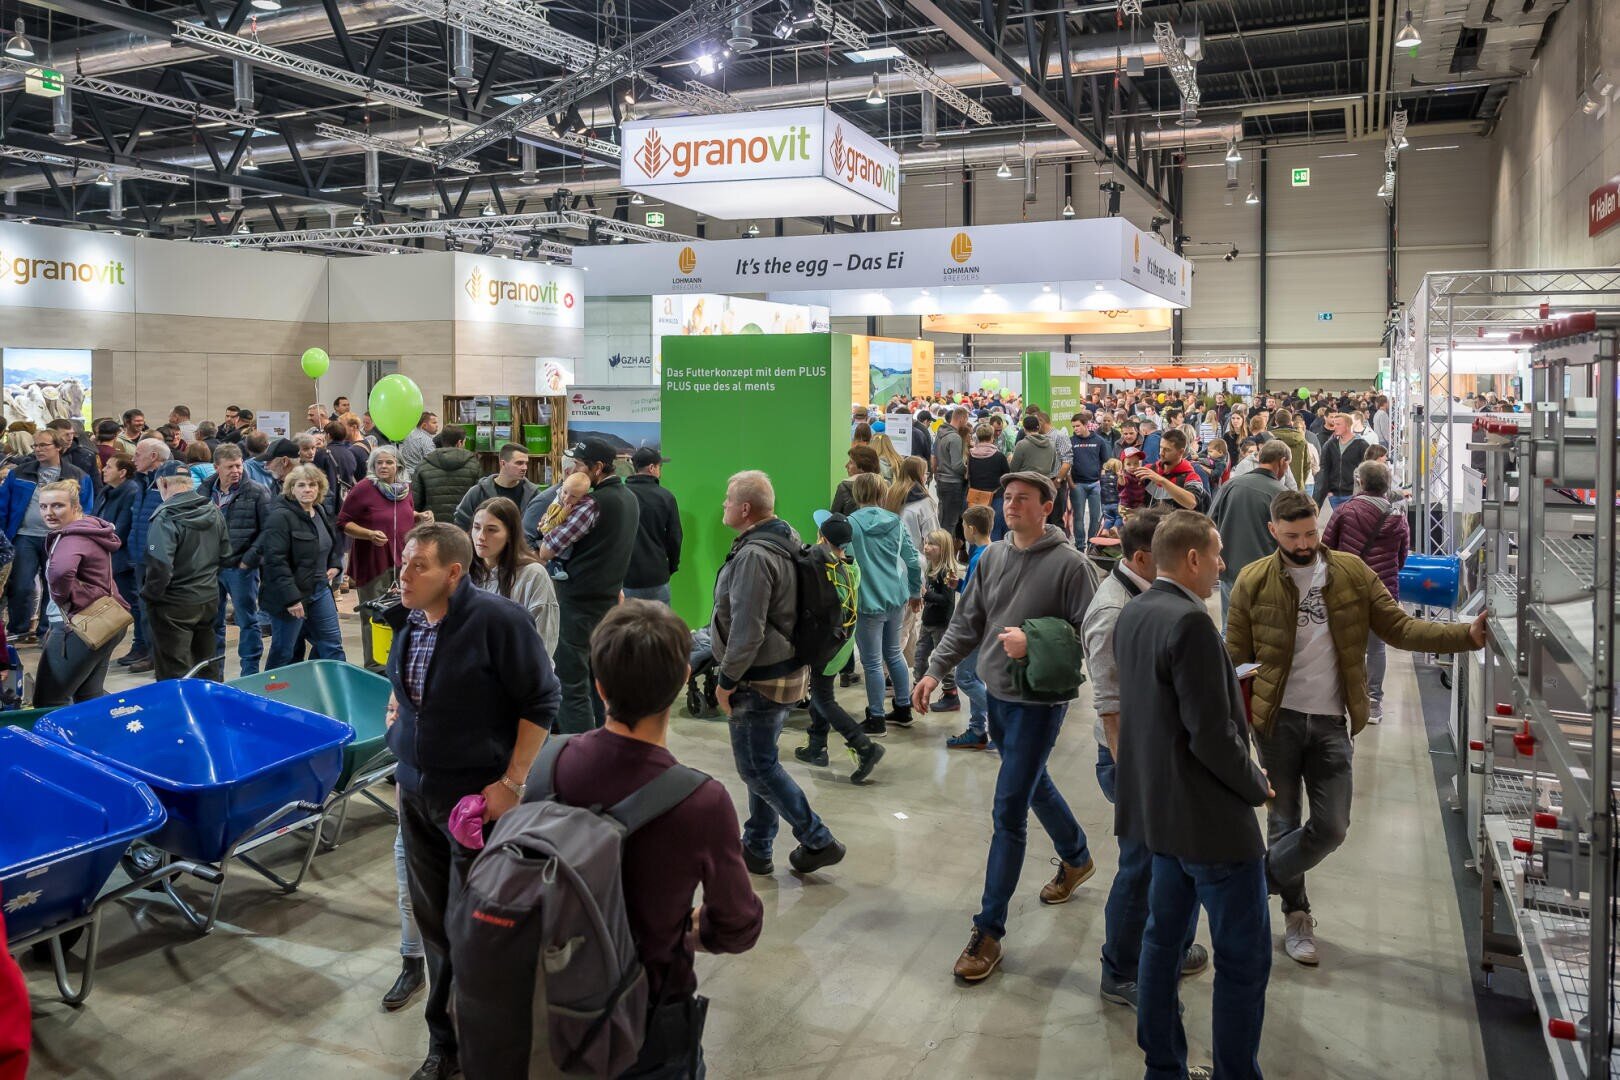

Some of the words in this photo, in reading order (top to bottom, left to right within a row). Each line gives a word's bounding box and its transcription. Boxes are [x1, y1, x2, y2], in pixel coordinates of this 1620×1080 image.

[672, 125, 811, 177] granovit
[846, 144, 896, 196] granovit
[1596, 192, 1616, 222] Hallen
[12, 257, 126, 285] granovit
[764, 256, 791, 274] the
[795, 258, 829, 277] egg
[847, 254, 882, 271] Das
[886, 251, 904, 269] Ei
[943, 266, 980, 275] LOHMANN
[488, 280, 559, 306] granovit
[621, 356, 638, 365] GZH
[639, 356, 651, 364] AG
[667, 367, 684, 377] Das
[686, 367, 753, 379] Futterkonzept
[755, 367, 772, 377] mit
[774, 367, 796, 377] dem
[799, 366, 826, 377] PLUS
[667, 381, 691, 391] PLUS
[693, 383, 711, 393] que
[713, 381, 730, 391] des
[582, 404, 611, 412] Grasag
